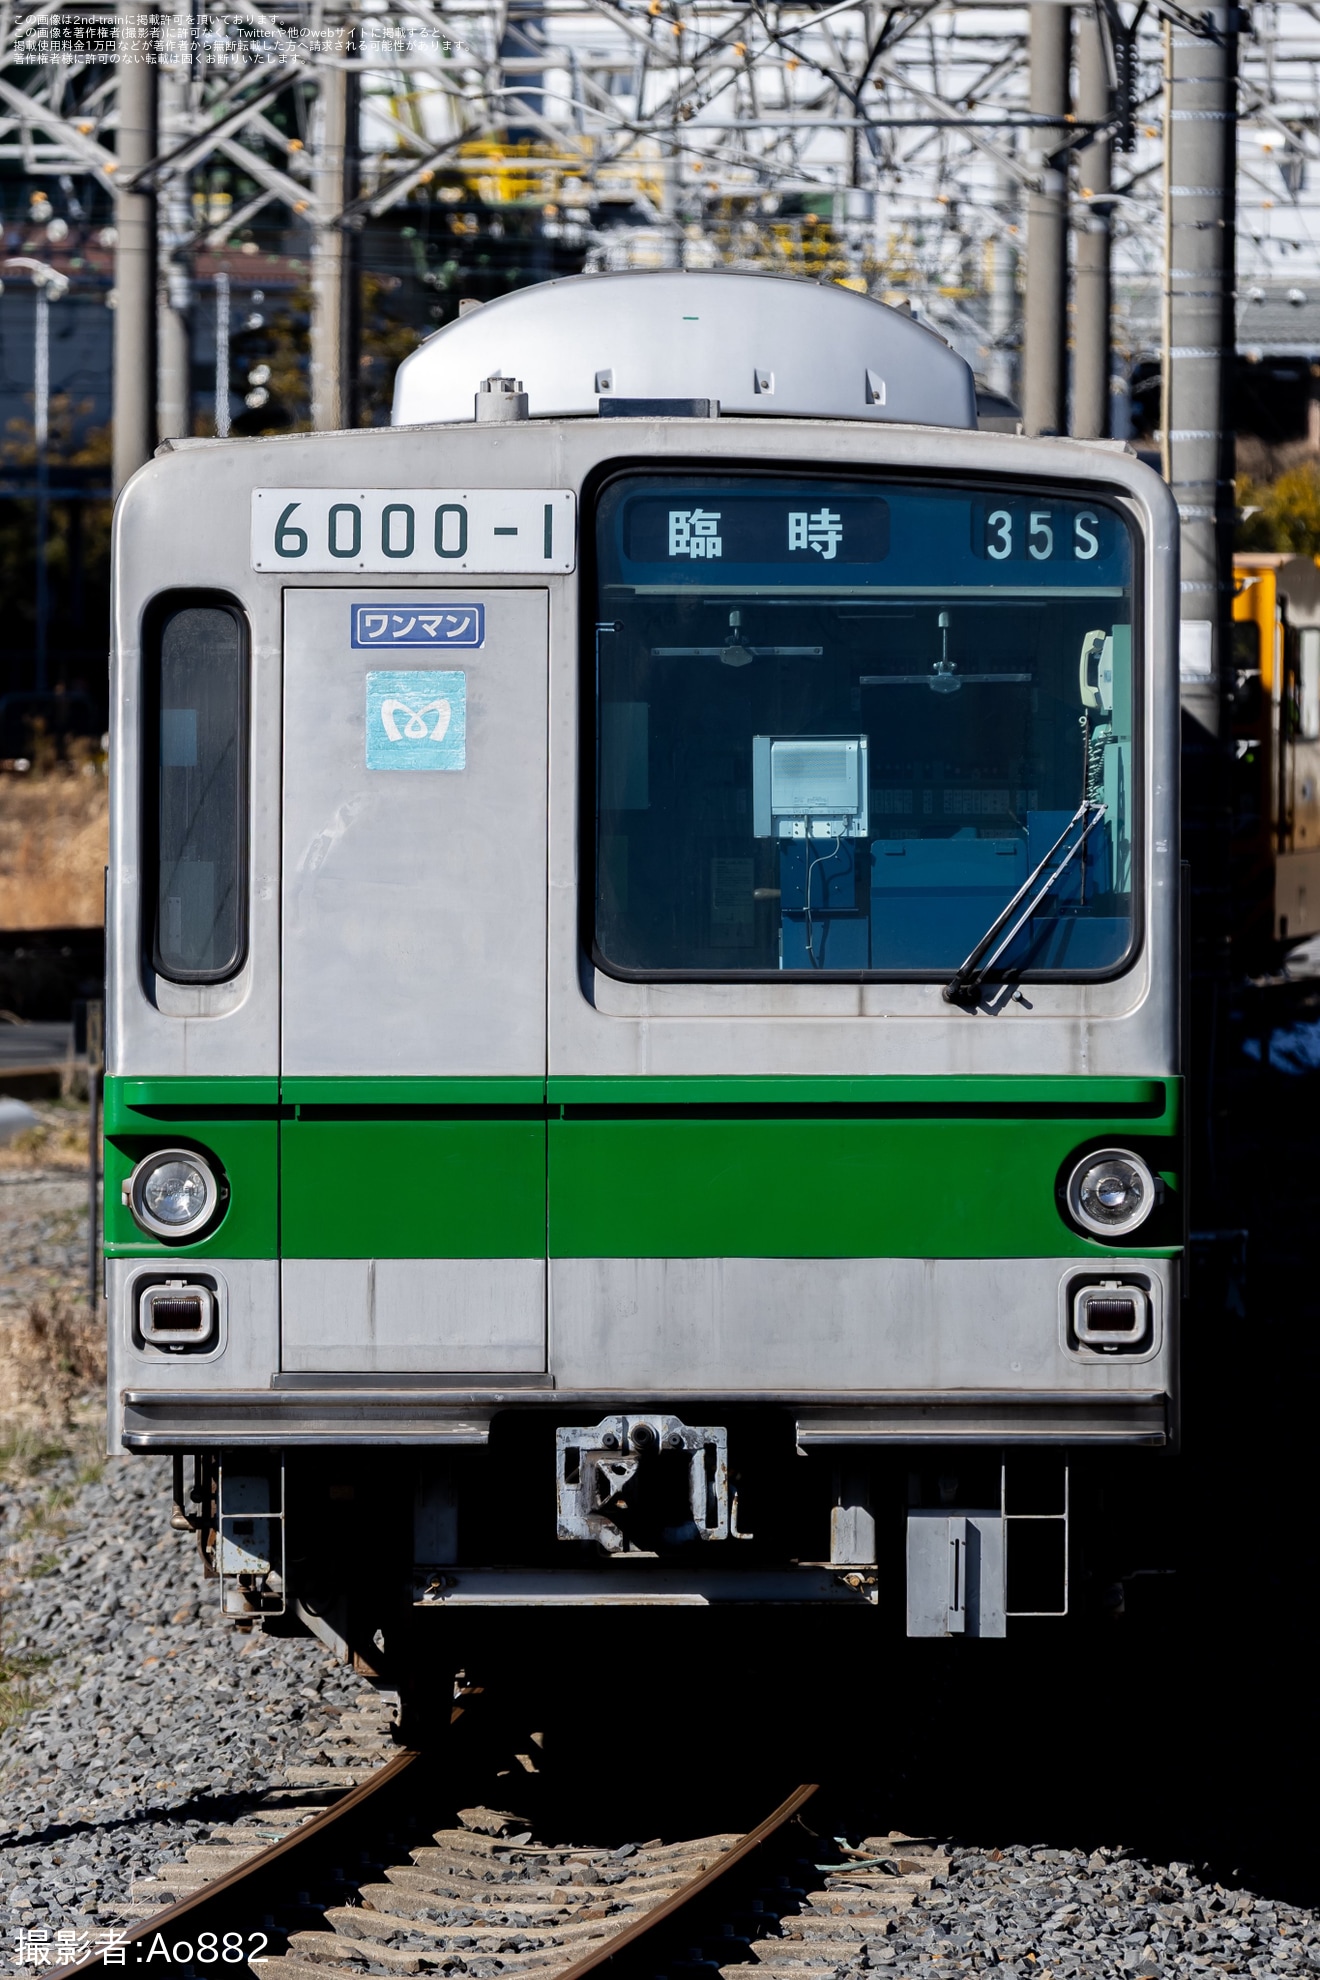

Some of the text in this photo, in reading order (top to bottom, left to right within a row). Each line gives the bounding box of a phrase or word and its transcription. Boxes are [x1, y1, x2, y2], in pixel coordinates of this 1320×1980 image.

[274, 502, 553, 559] 6000-1
[365, 614, 471, 639] ワンマン
